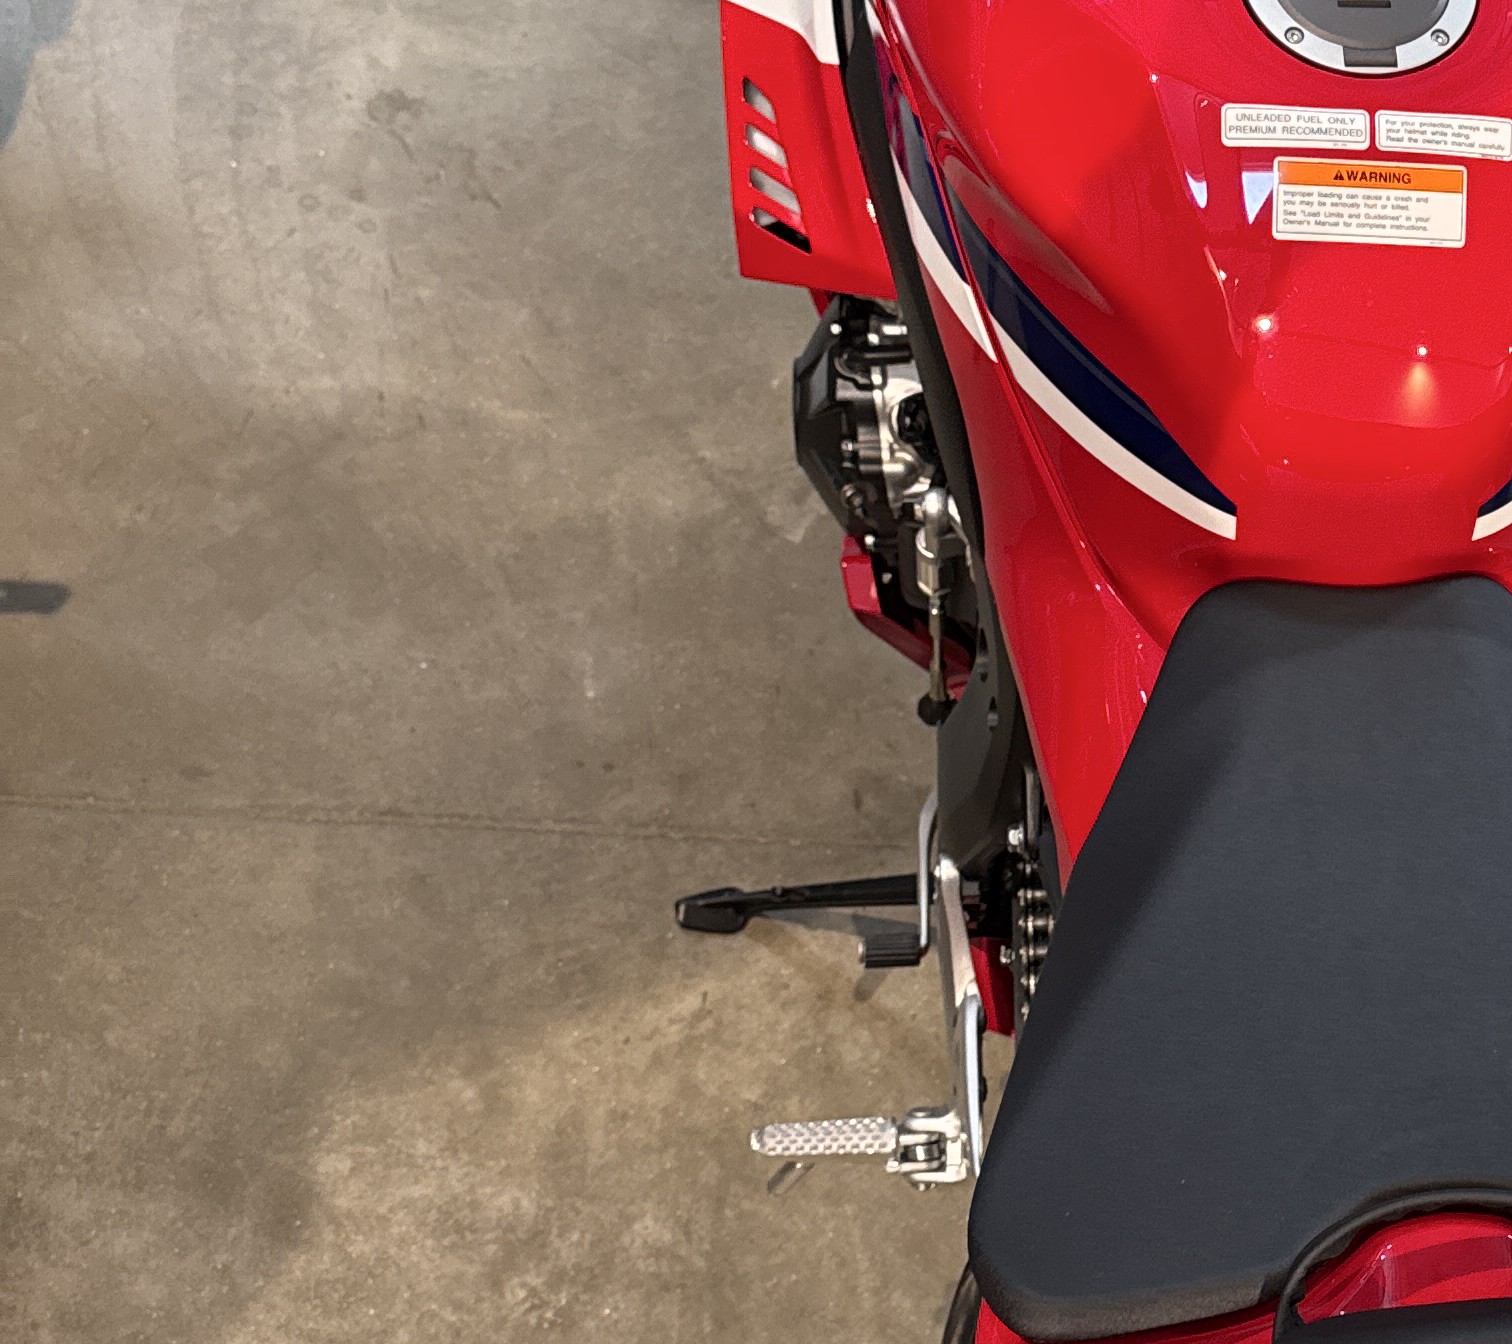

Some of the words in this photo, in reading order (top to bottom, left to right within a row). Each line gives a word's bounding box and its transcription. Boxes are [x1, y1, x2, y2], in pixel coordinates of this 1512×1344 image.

[1236, 113, 1291, 122] UNLEADED
[1297, 116, 1322, 124] FUEL
[1328, 117, 1356, 125] ONLY
[1228, 125, 1276, 134] PREMIUM
[1282, 126, 1363, 137] RECOMMENDED
[1458, 124, 1480, 132] always
[1451, 140, 1475, 148] manual
[1346, 170, 1412, 184] WARNING
[1283, 189, 1314, 199] Improper
[1317, 191, 1342, 200] loading
[1299, 200, 1314, 208] may
[1330, 201, 1361, 210] seriously
[1282, 218, 1311, 226] Owner's
[1314, 219, 1339, 227] Manual
[1356, 222, 1386, 230] complete
